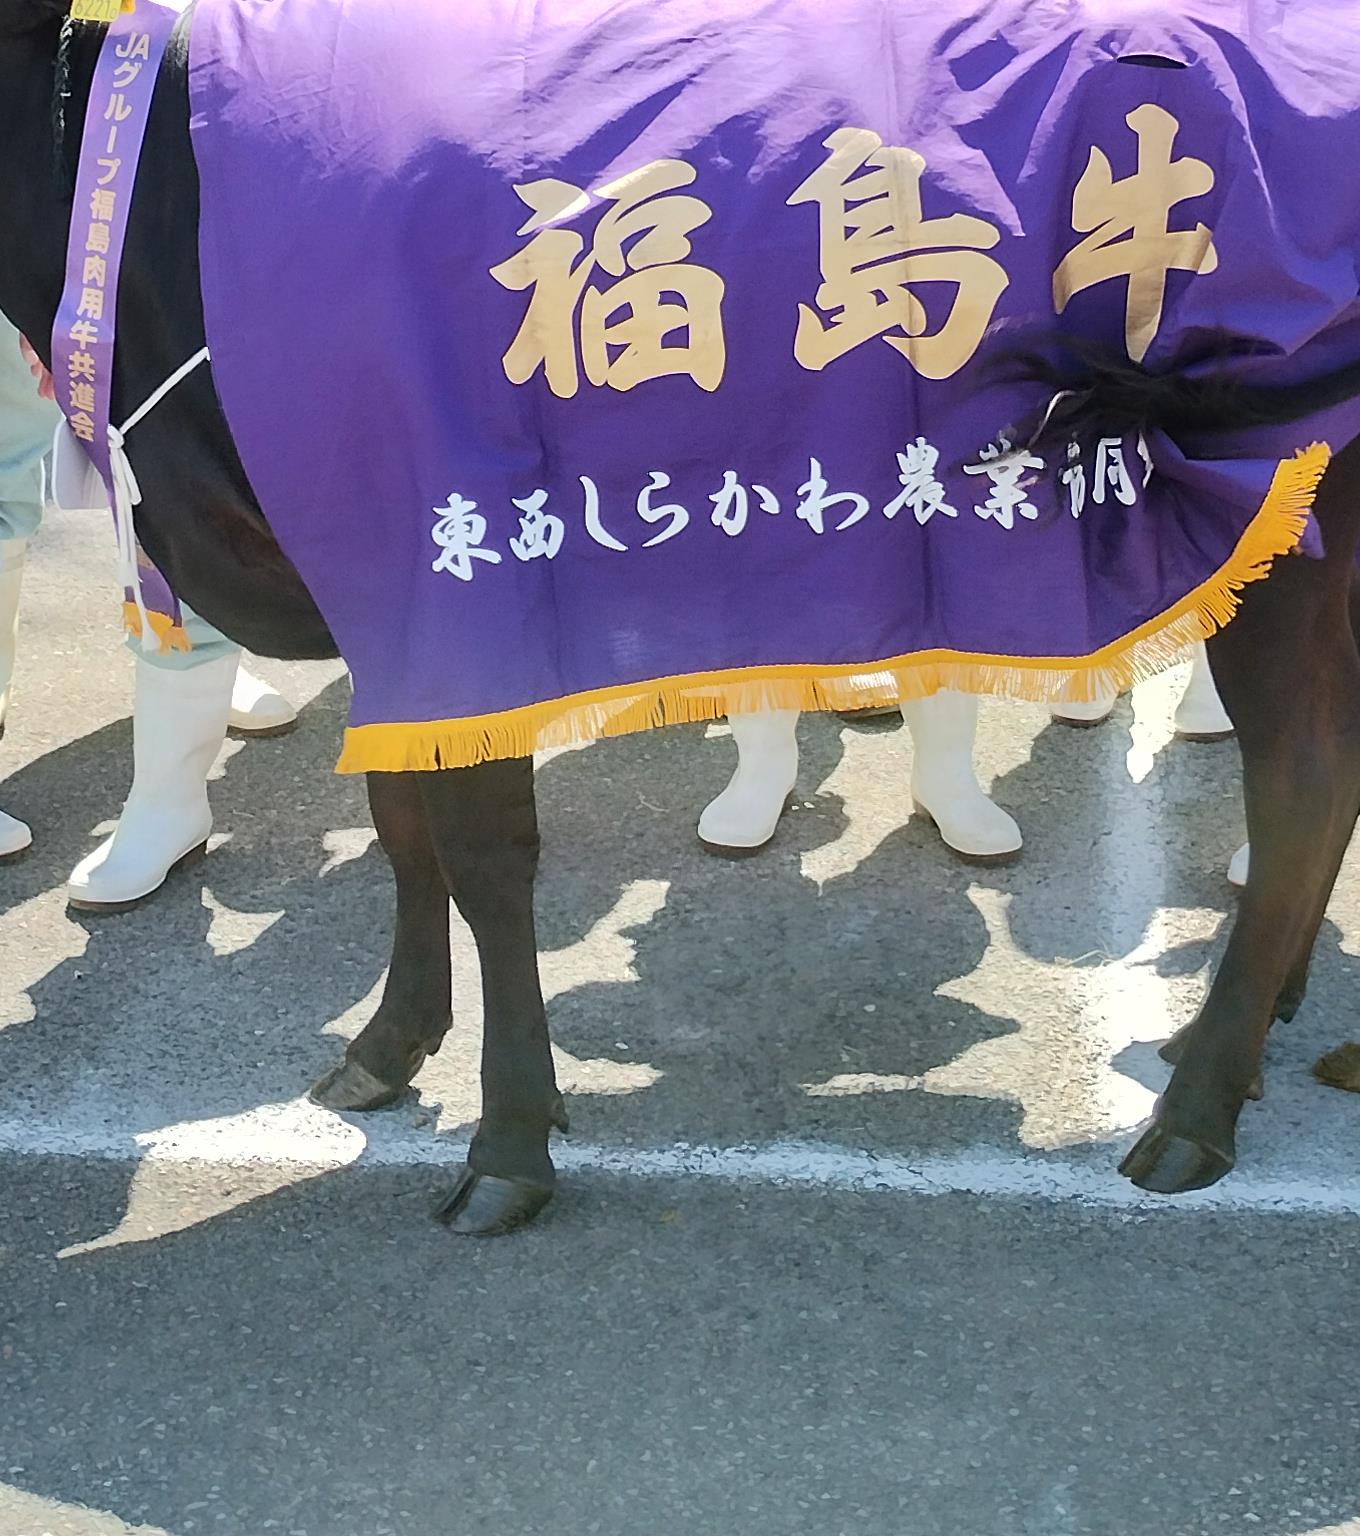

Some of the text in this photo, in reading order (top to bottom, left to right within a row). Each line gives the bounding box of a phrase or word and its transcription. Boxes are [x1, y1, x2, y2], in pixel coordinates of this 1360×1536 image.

[67, 31, 151, 443] JAグループ福島肉用牛共進会
[489, 102, 1218, 399] 福島牛
